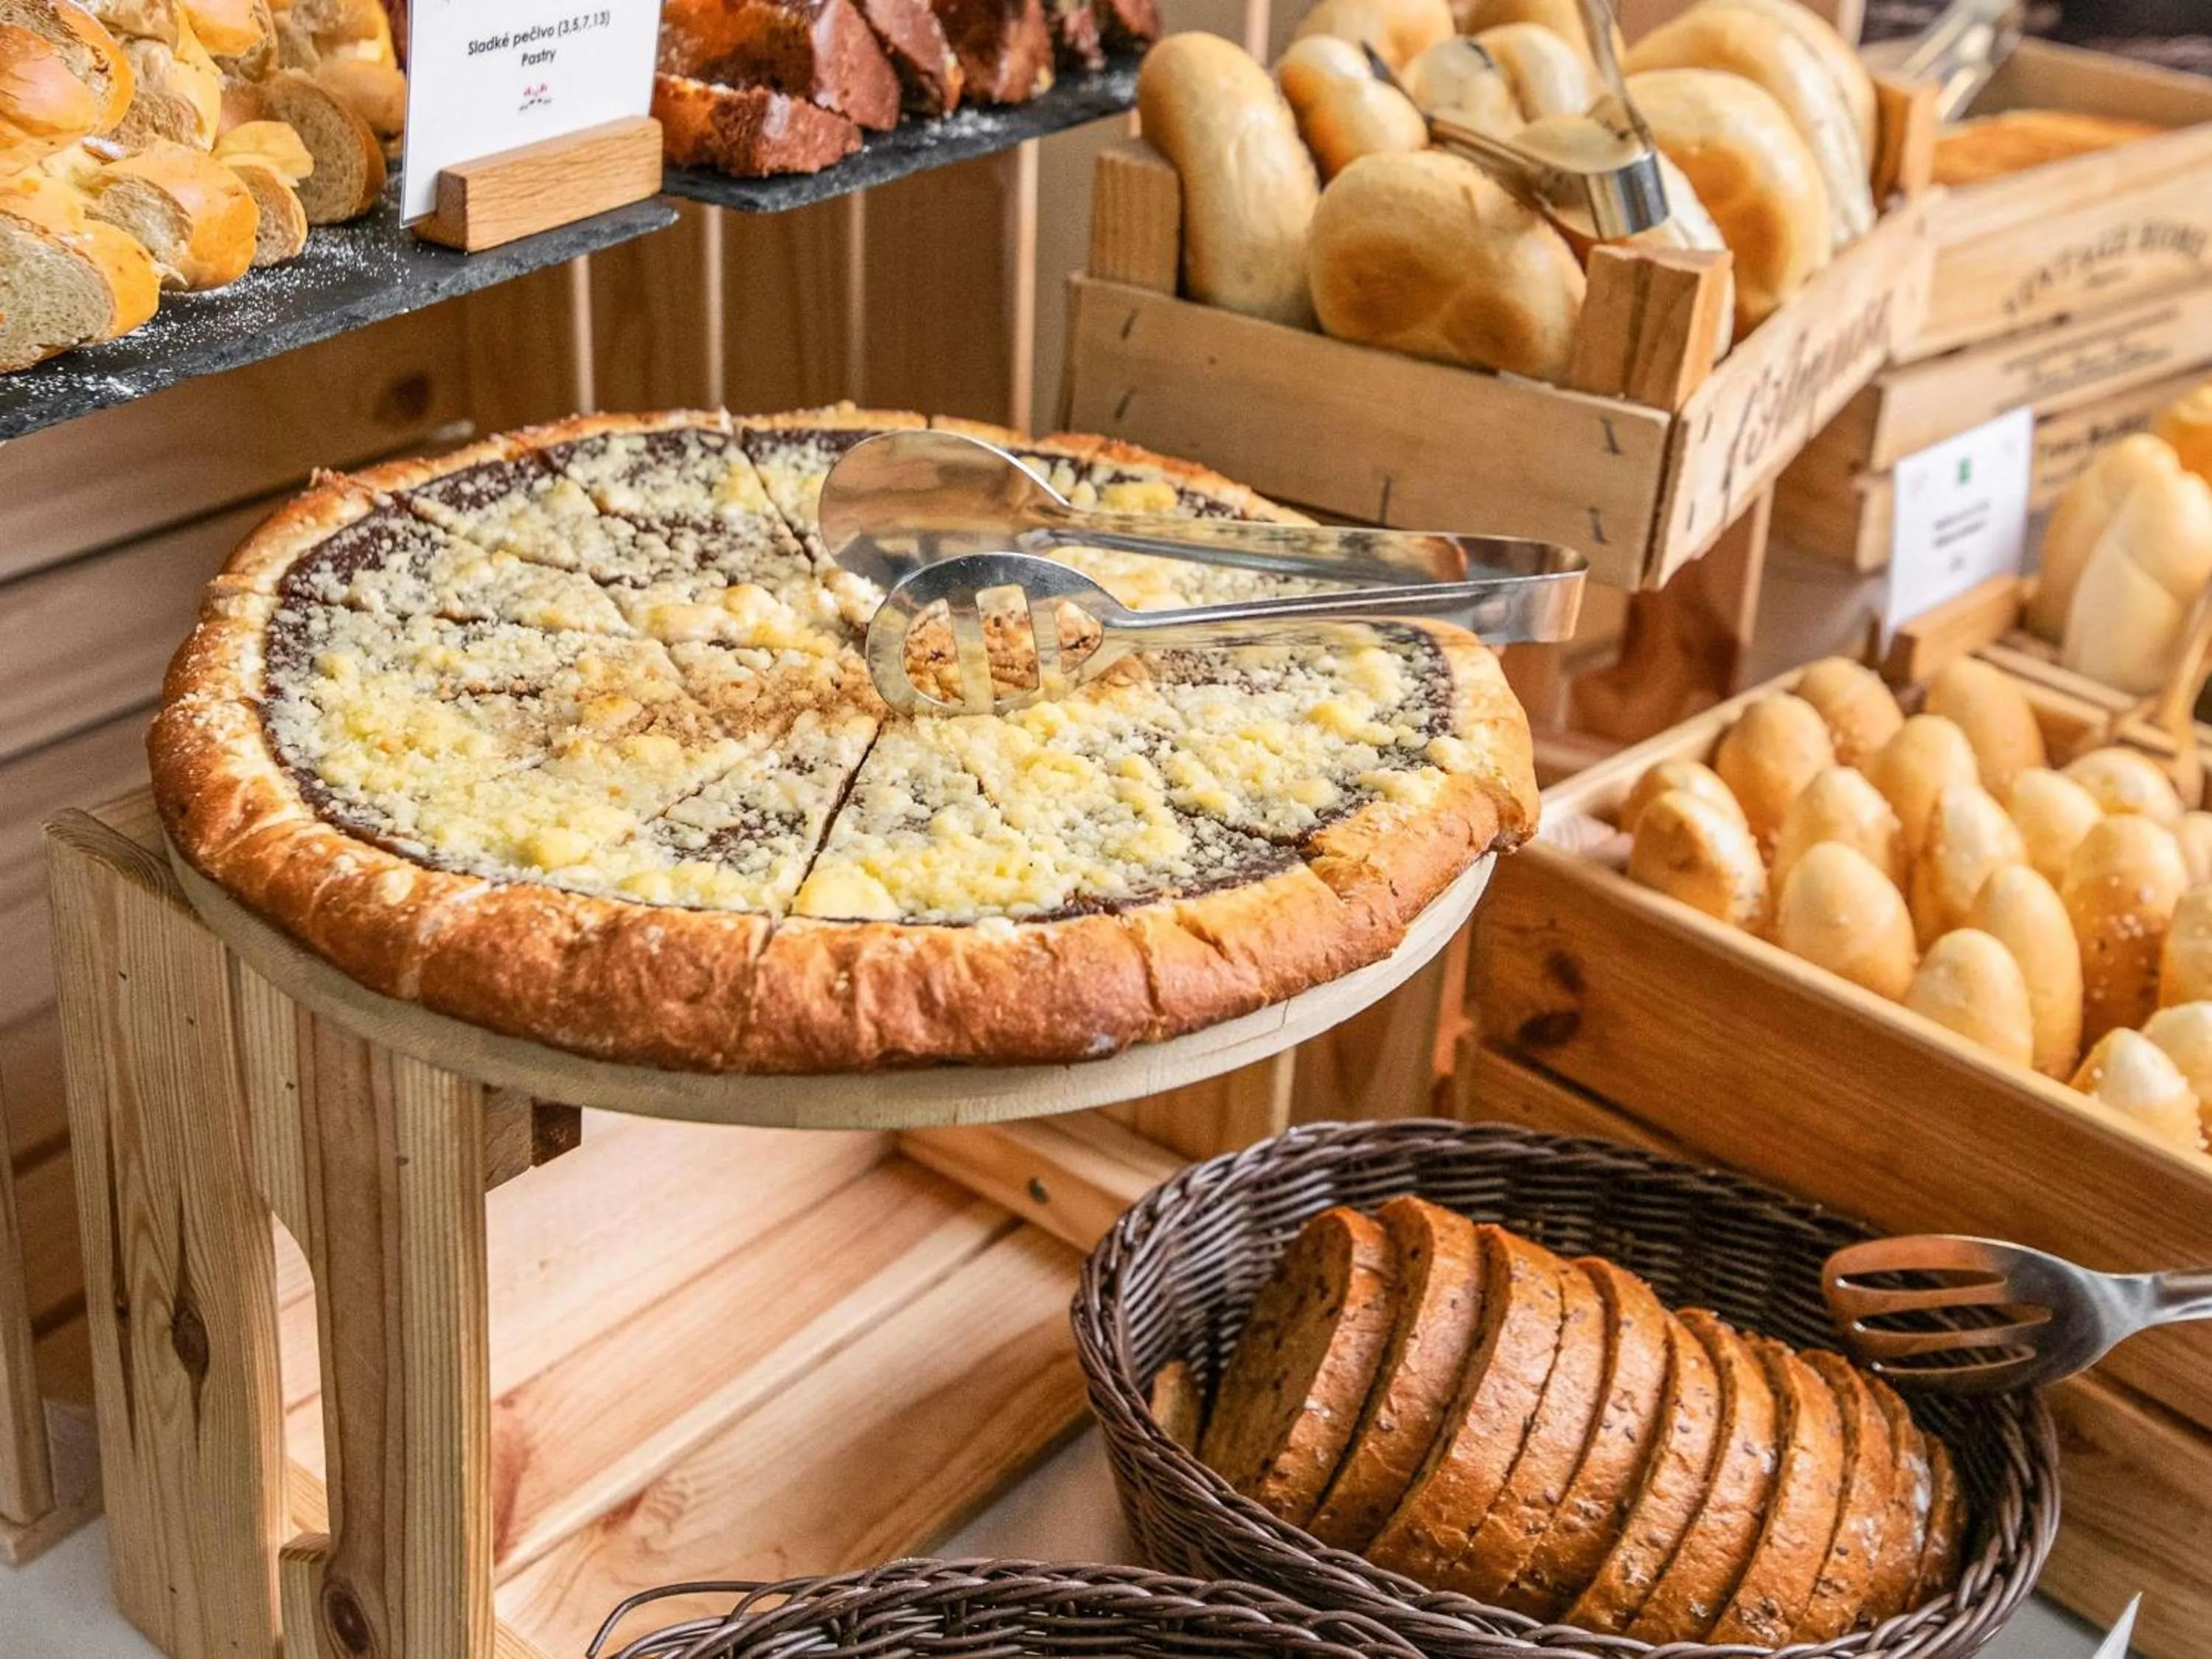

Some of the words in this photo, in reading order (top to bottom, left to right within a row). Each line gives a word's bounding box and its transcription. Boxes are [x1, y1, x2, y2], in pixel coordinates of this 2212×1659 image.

[467, 32, 509, 56] Sladké
[512, 25, 554, 48] pečivo
[521, 48, 557, 66] Pastry
